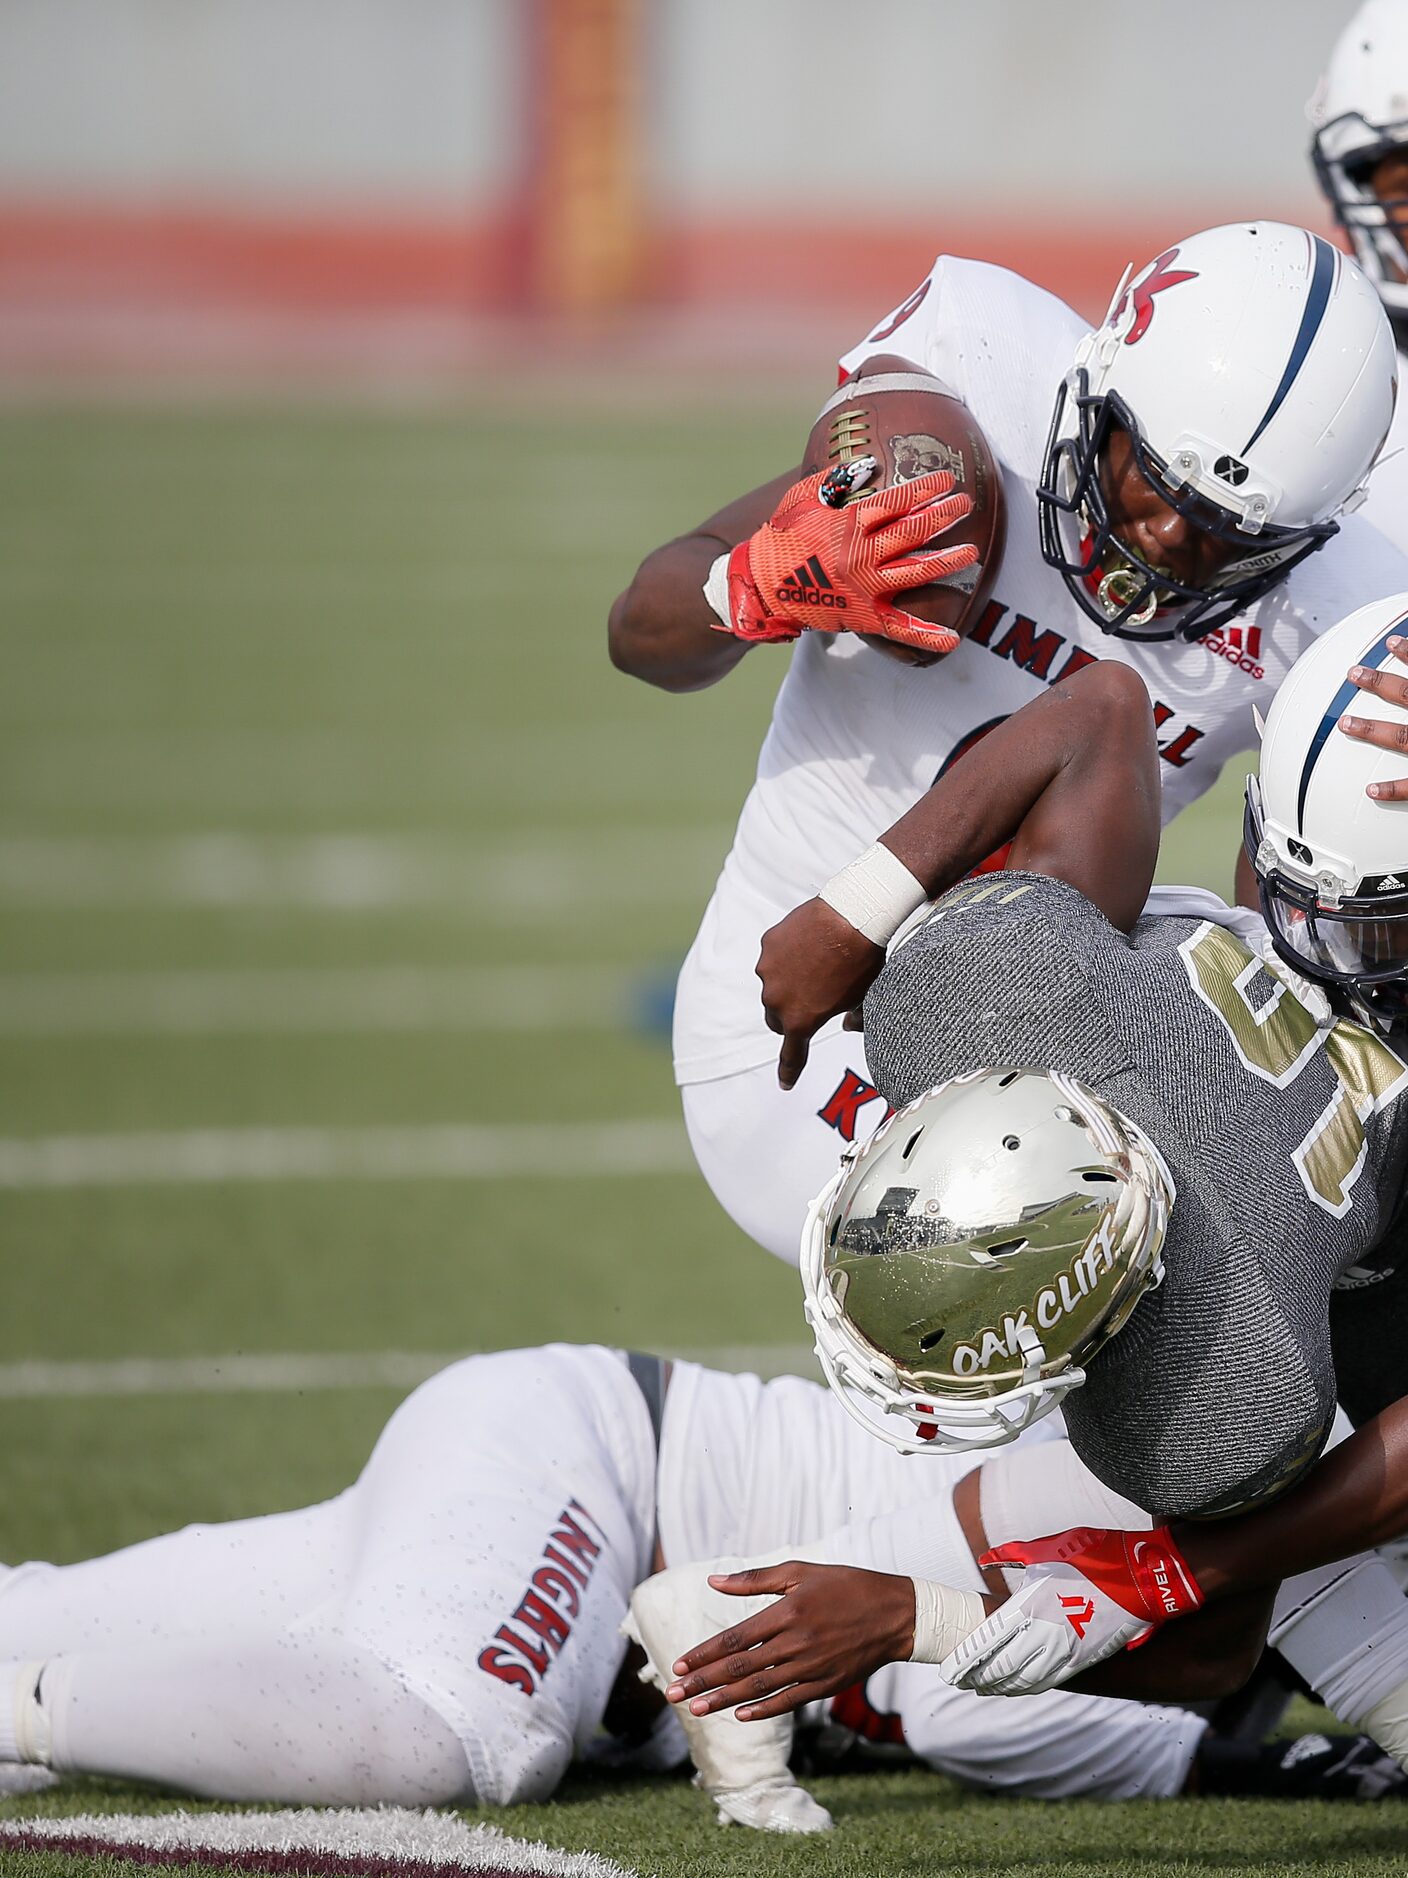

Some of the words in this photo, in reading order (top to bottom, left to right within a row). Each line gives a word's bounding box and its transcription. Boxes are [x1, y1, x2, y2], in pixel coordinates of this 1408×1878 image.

[776, 586, 847, 609] adidas
[1377, 881, 1406, 892] adidas
[953, 1310, 1028, 1376] OAK
[1037, 1212, 1117, 1329] CLIFF
